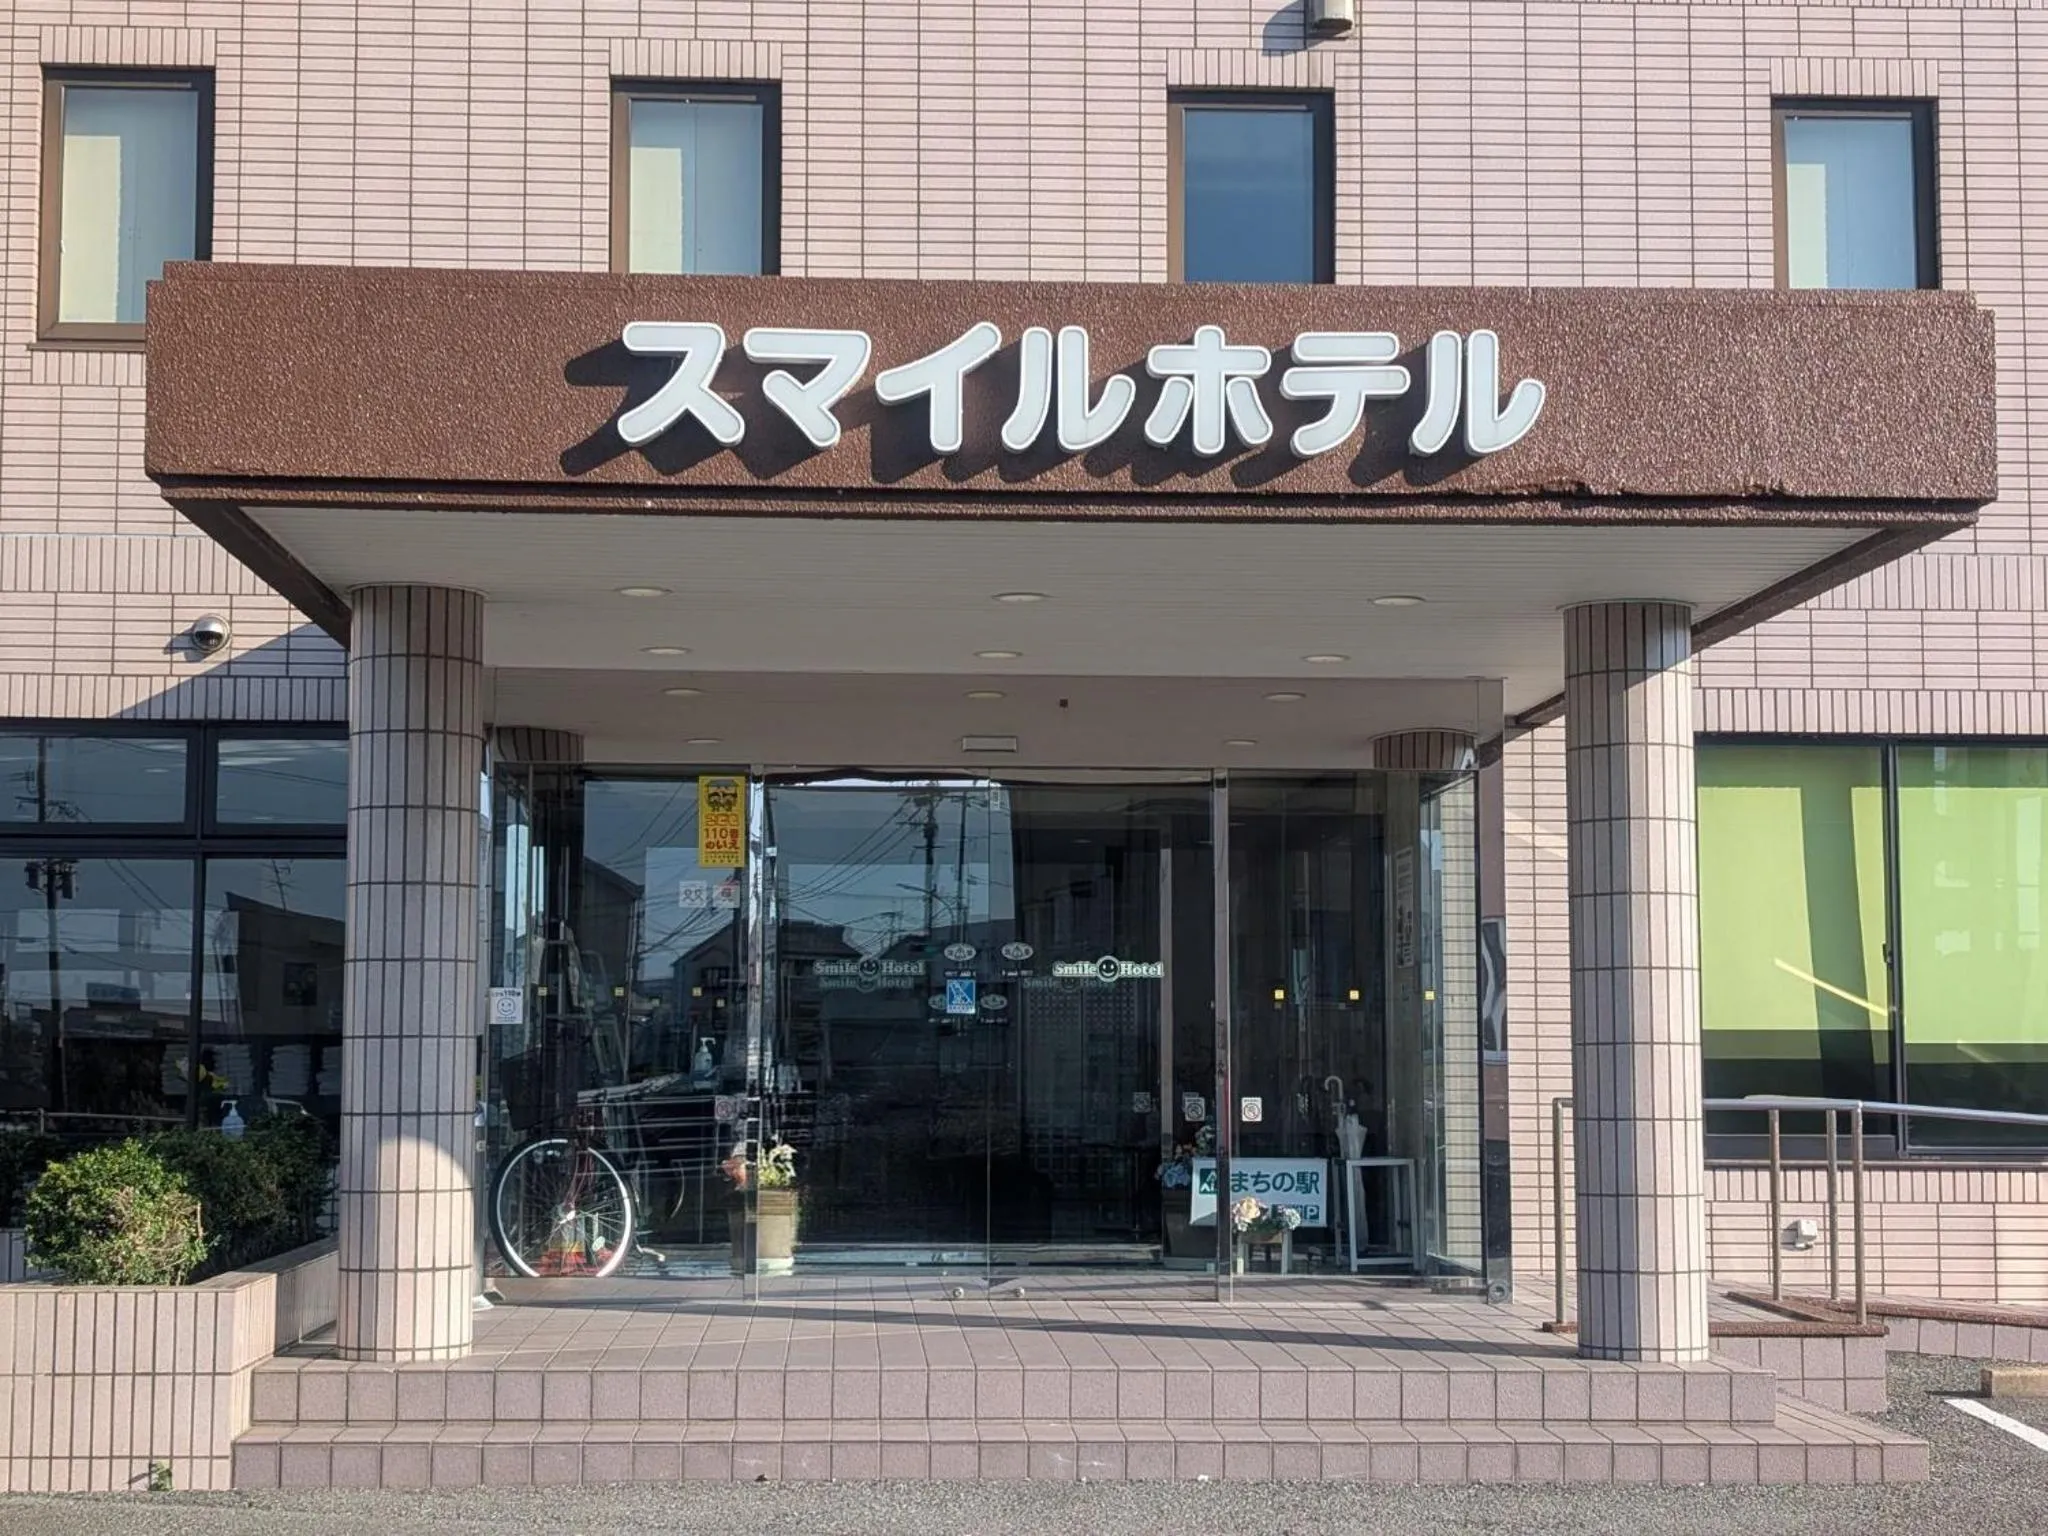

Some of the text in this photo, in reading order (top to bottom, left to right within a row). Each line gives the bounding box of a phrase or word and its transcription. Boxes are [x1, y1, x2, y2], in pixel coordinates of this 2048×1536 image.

[617, 320, 1547, 457] スマイルホテル
[813, 959, 858, 975] Smile
[880, 959, 926, 975] Hotel
[1052, 960, 1097, 977] Smile
[1120, 961, 1164, 977] Hotel
[1231, 1170, 1320, 1195] まちの駅
